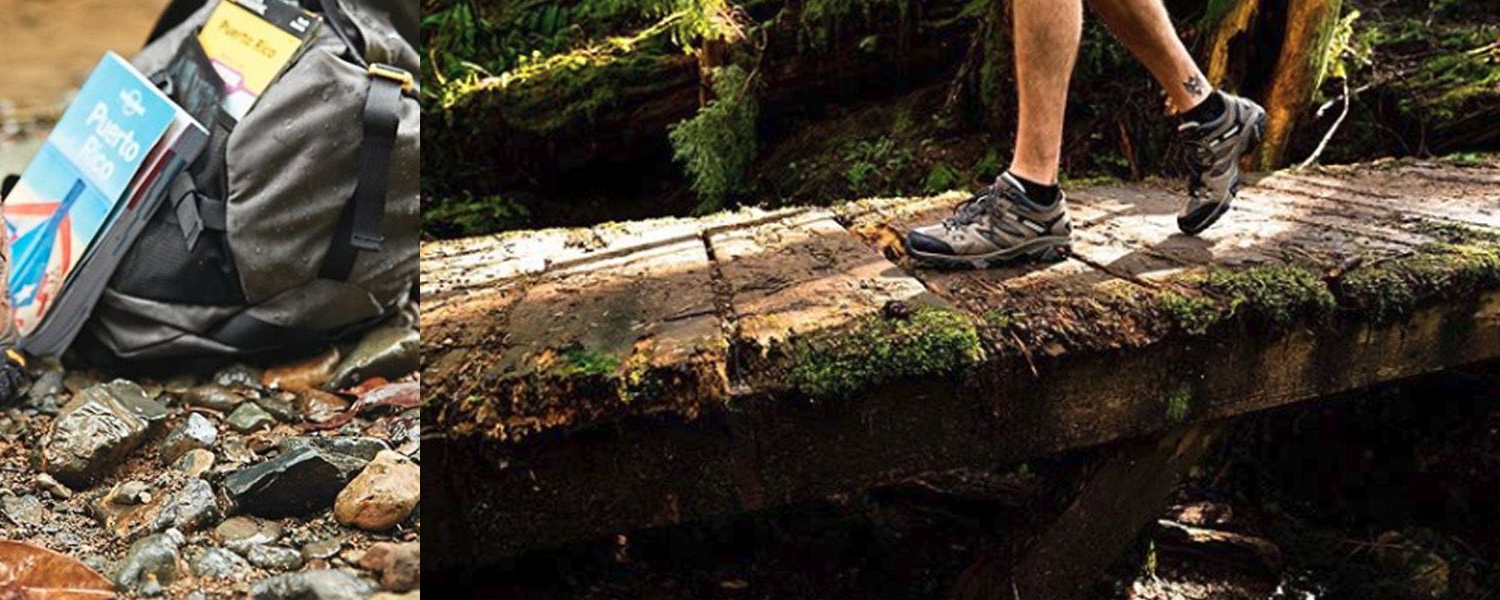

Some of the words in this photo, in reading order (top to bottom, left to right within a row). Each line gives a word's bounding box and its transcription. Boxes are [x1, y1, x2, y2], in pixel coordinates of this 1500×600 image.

[219, 19, 254, 47] Puerto
[255, 39, 276, 58] Rico
[85, 101, 140, 163] Puerto
[77, 136, 115, 182] Rico
